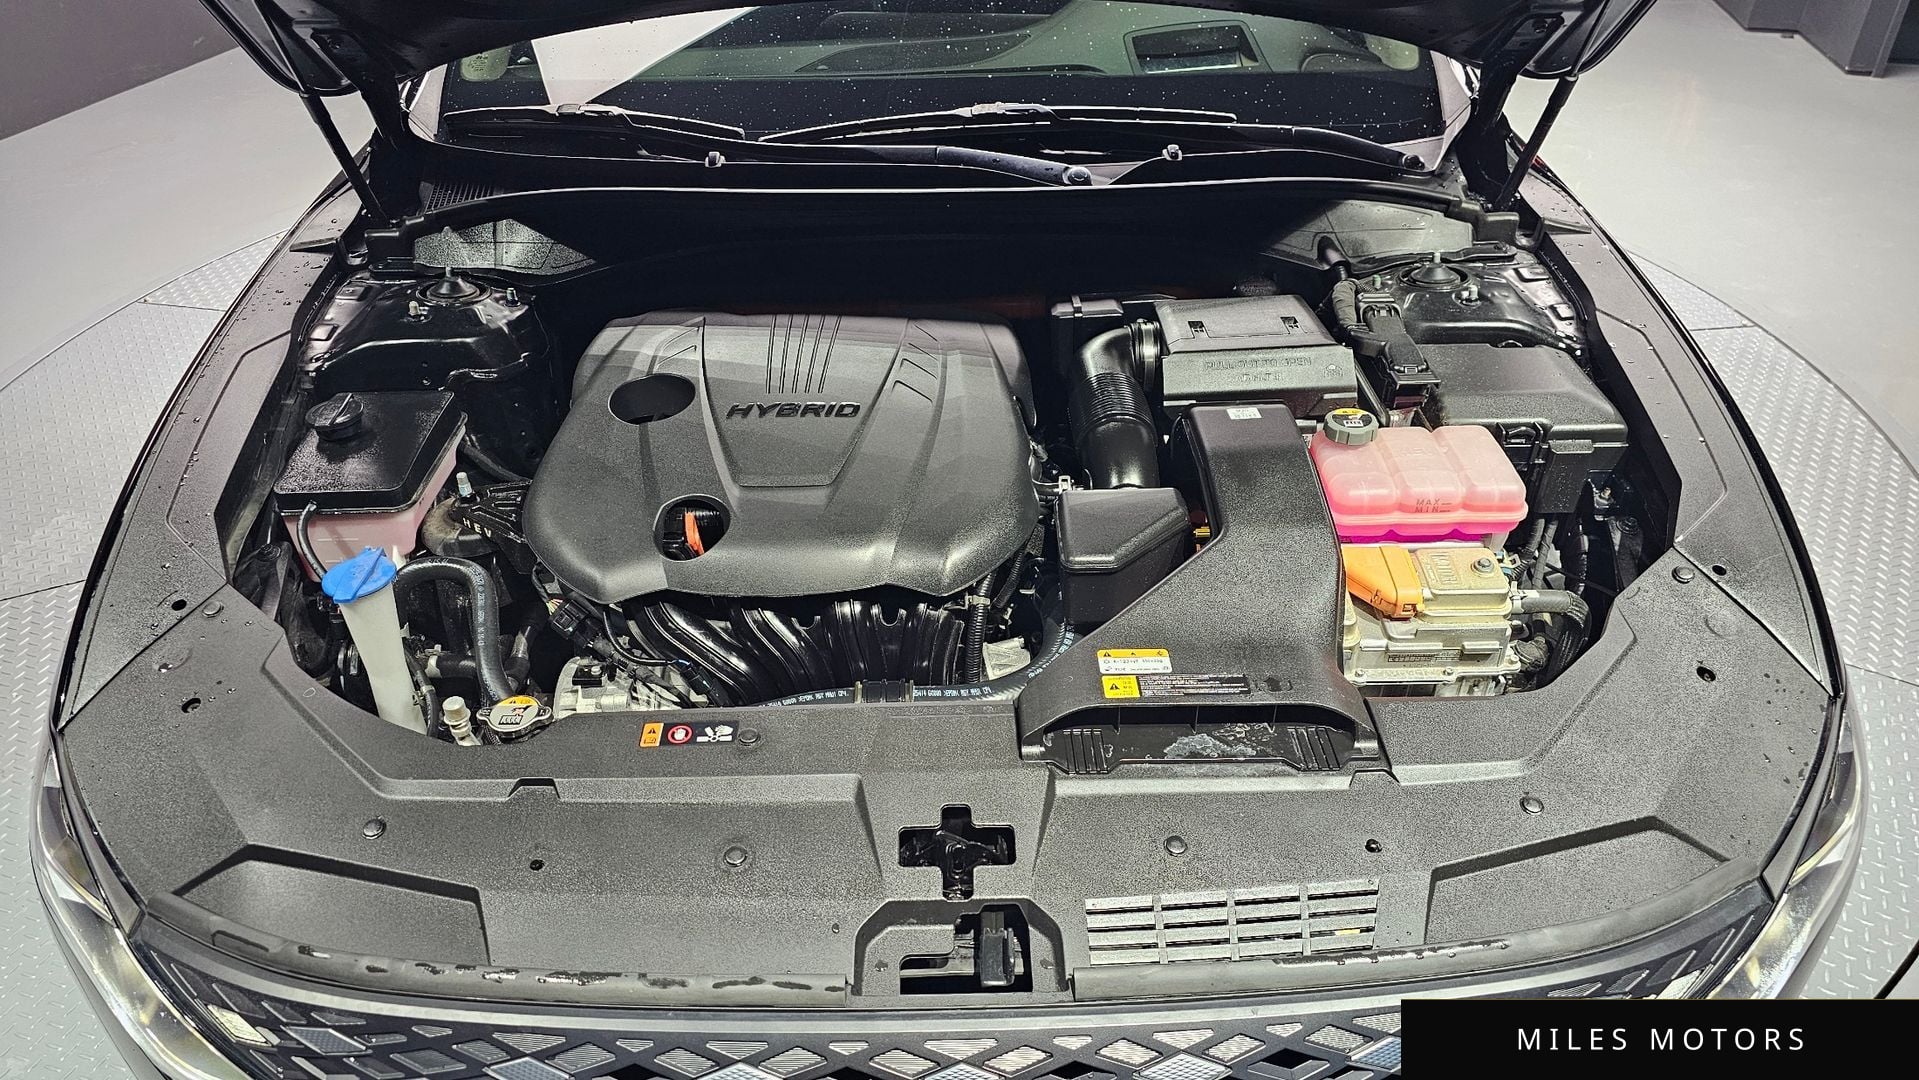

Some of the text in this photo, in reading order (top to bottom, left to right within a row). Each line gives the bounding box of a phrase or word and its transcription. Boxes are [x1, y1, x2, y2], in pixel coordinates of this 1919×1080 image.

[1205, 360, 1235, 370] PULL
[1281, 356, 1312, 367] OPEN
[726, 402, 861, 419] HYBRID
[1416, 498, 1440, 506] MAX
[462, 517, 492, 538] HEV
